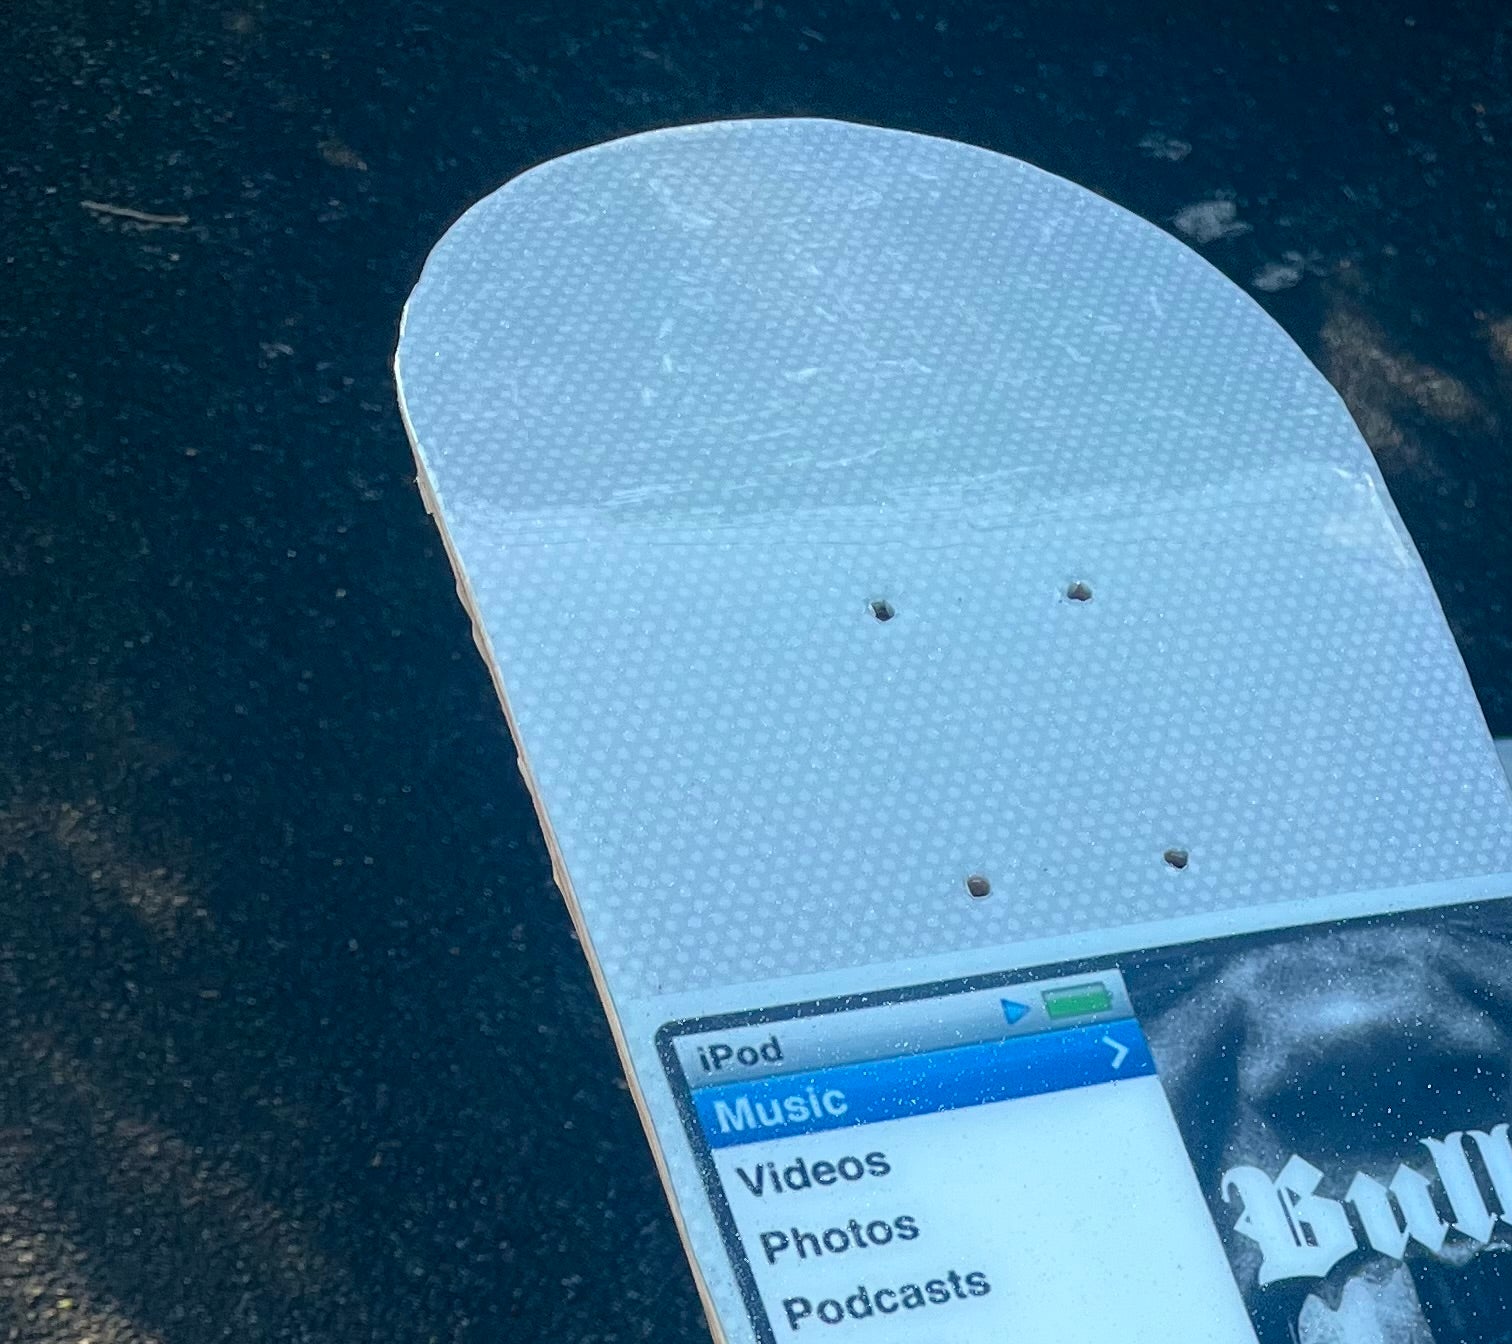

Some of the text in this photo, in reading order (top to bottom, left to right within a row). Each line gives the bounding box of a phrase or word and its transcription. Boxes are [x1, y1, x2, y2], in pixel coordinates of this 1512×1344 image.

[698, 1035, 784, 1072] iPod
[715, 1086, 849, 1133] Music
[736, 1150, 892, 1198] Videos
[759, 1213, 921, 1264] Photos
[782, 1269, 991, 1330] Podcasts
